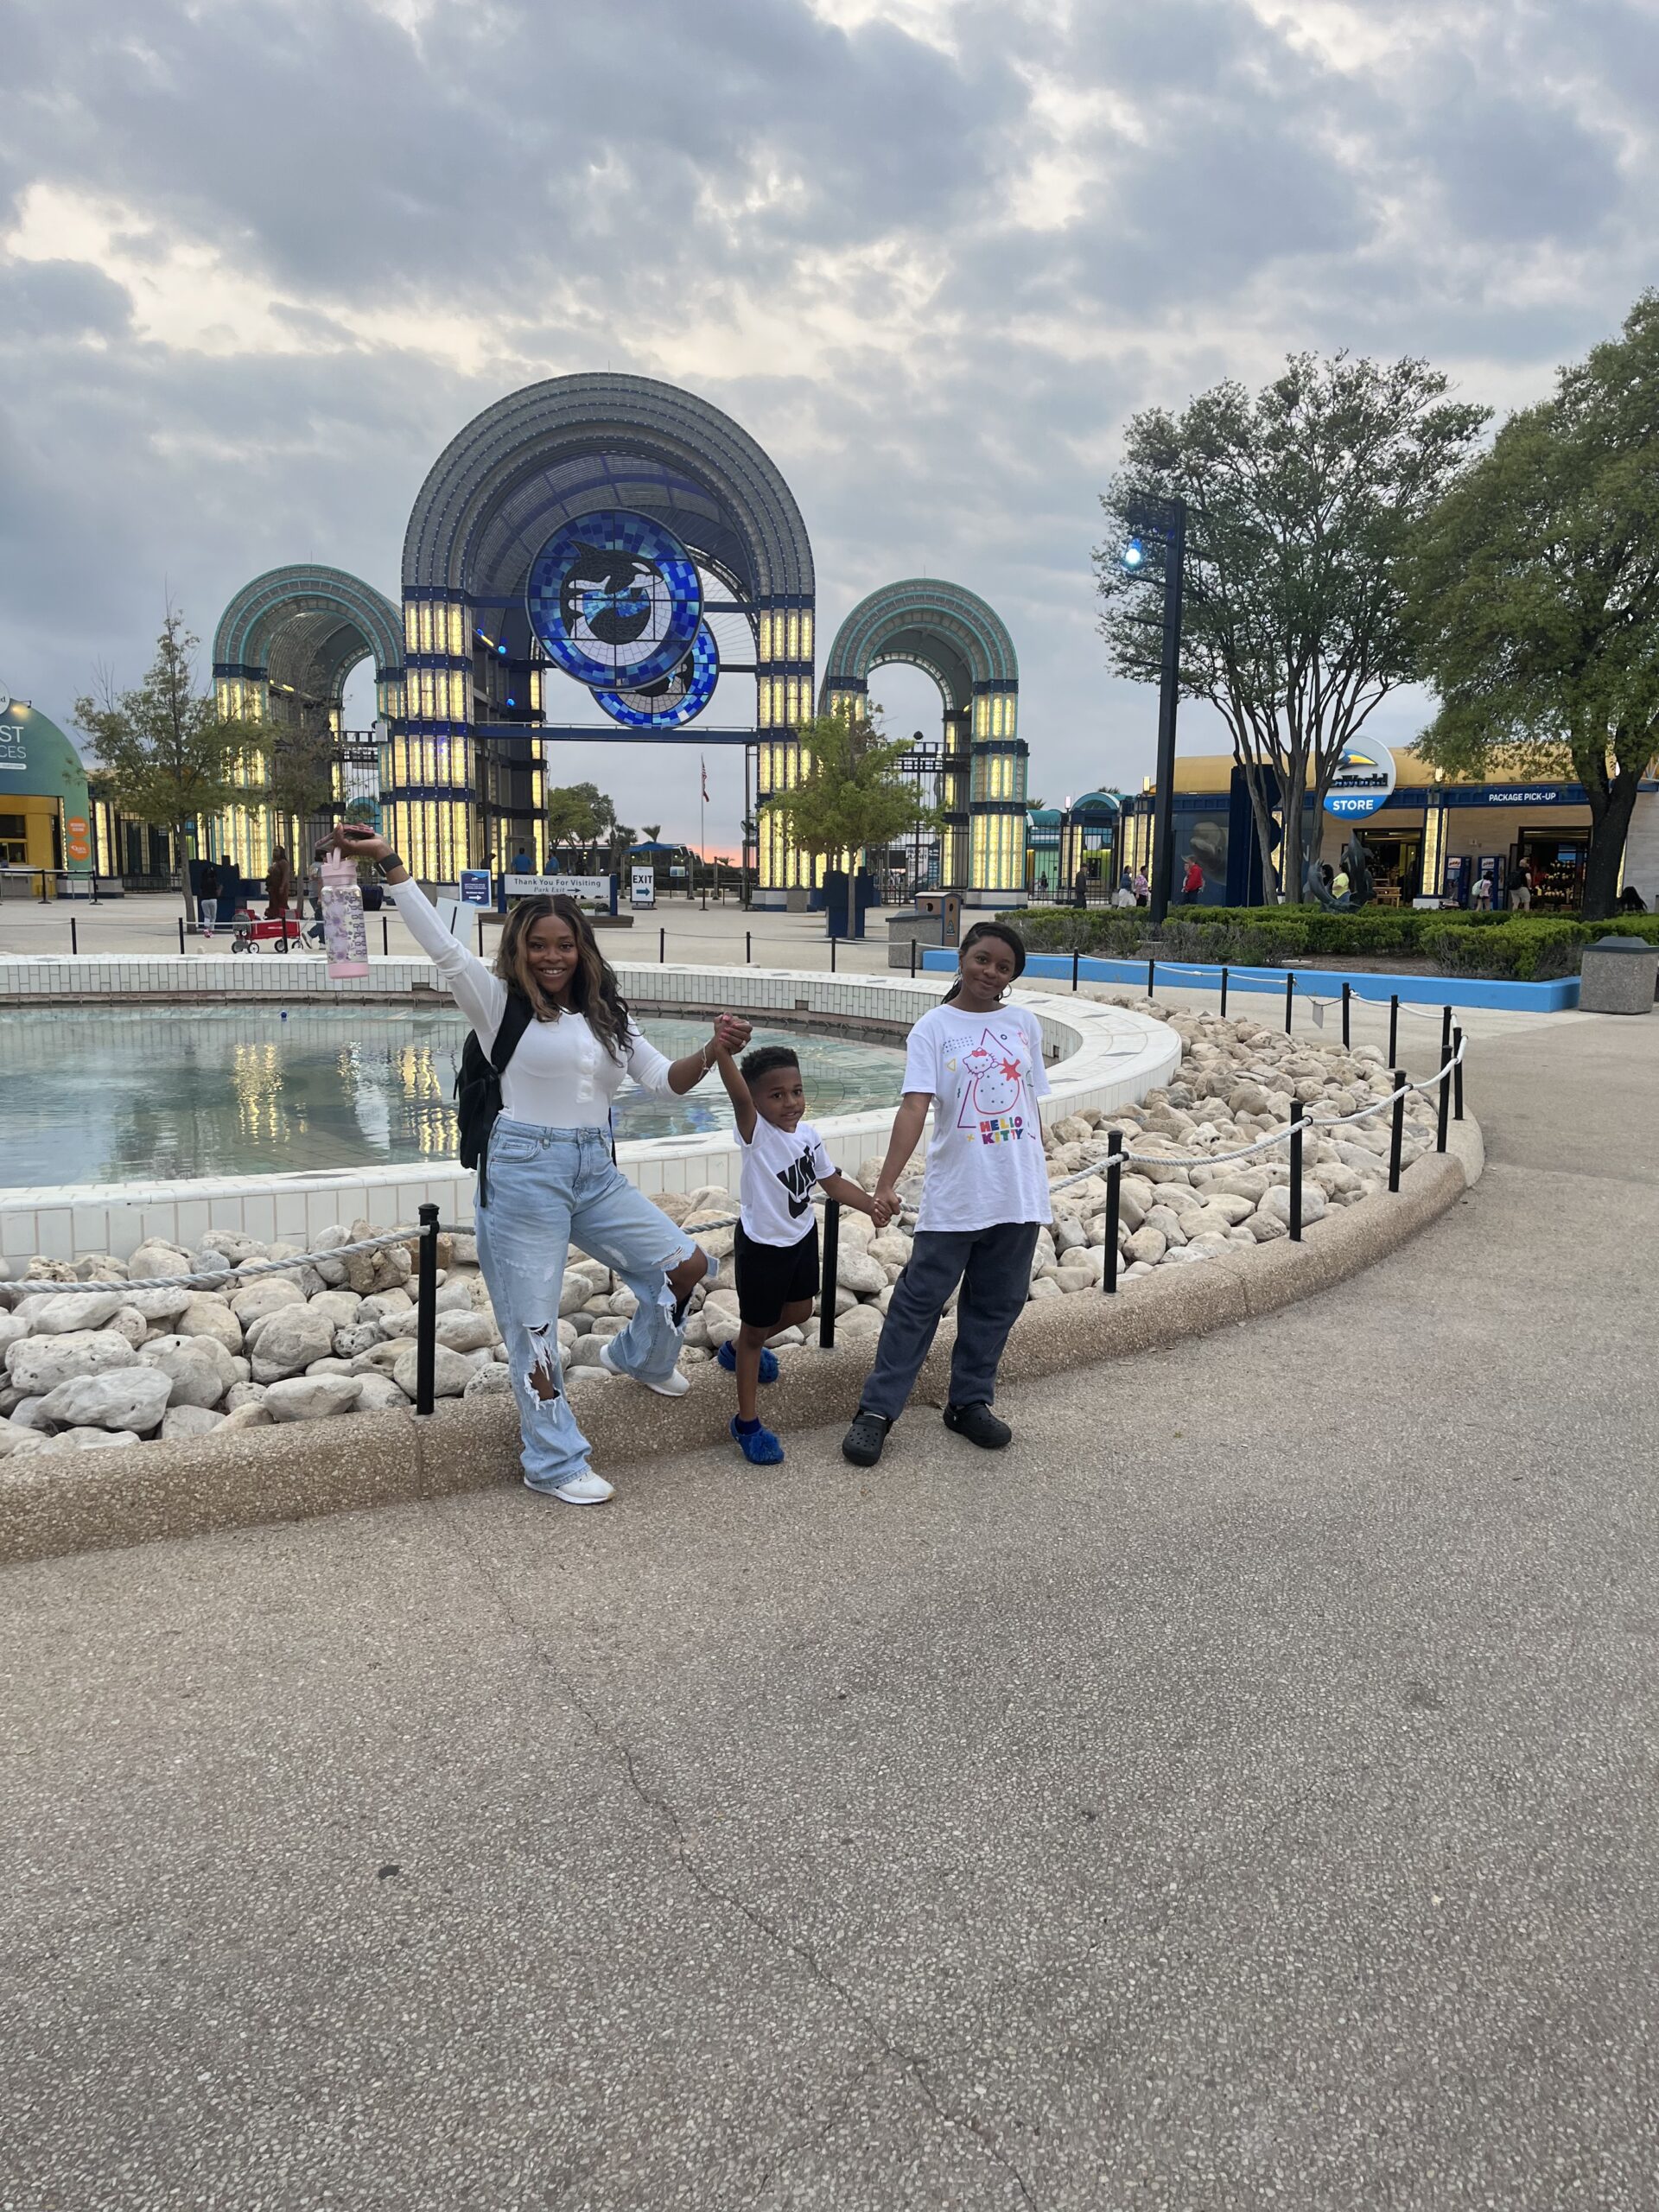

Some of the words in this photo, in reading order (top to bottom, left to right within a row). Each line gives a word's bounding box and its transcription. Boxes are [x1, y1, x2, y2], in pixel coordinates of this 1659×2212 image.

[1489, 793, 1523, 802] PACKAGE
[1523, 792, 1556, 801] PICK-UP
[1332, 799, 1374, 810] STORE
[632, 874, 653, 884] EXIT
[980, 1116, 1023, 1133] HELLO
[982, 1128, 1024, 1145] KITTY
